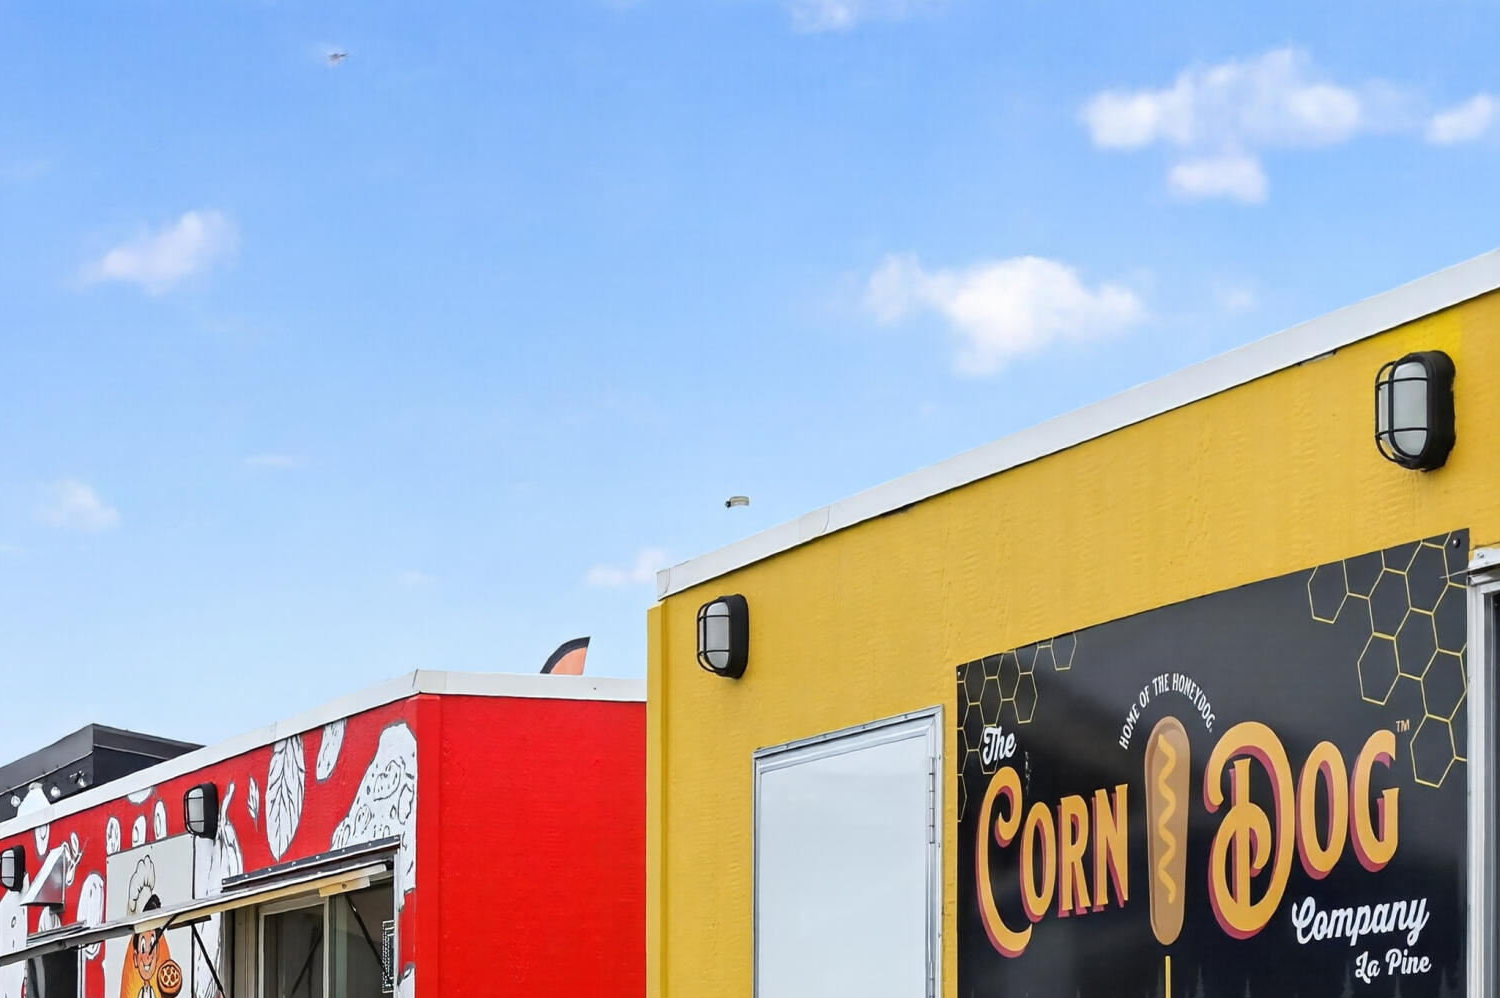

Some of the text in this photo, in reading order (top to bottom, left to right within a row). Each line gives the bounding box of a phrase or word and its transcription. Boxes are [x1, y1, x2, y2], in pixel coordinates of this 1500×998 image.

[1119, 704, 1140, 750] HOME
[1139, 685, 1150, 708] OF
[1152, 673, 1170, 696] THE
[983, 726, 1016, 765] The
[1292, 896, 1430, 946] Company
[1355, 949, 1432, 983] La Pine
